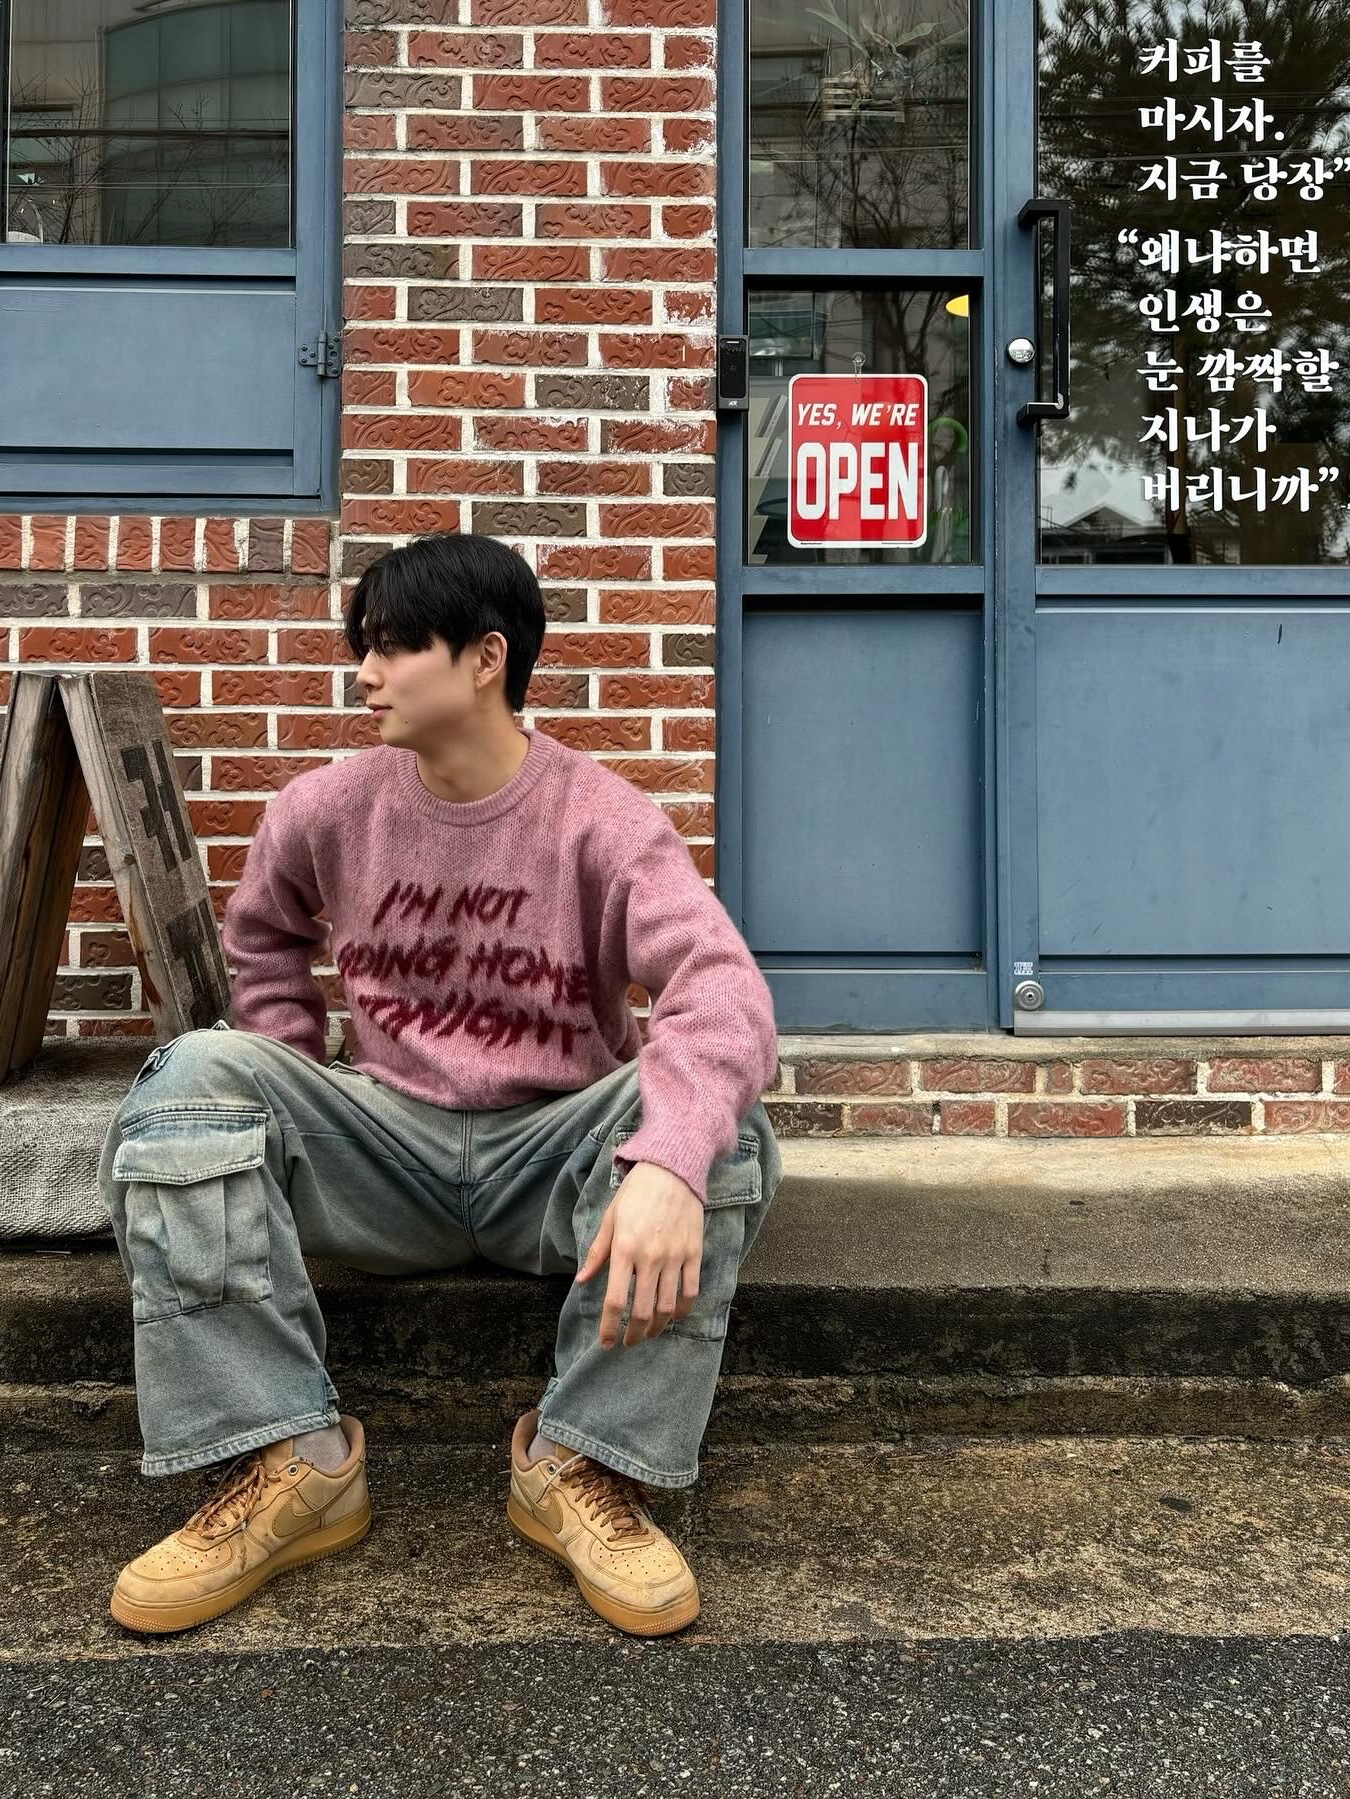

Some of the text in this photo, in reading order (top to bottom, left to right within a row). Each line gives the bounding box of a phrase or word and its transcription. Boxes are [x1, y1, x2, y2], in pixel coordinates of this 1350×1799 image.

[1138, 37, 1271, 83] 커피를
[1138, 97, 1285, 142] 마시자.
[1137, 156, 1350, 201] 지금 당장”
[1117, 228, 1320, 274] “왜냐하면
[1139, 288, 1273, 333] 인생은
[1137, 348, 1340, 393] 눈 깜짝할
[797, 403, 920, 430] YES, WE'RE
[1139, 407, 1277, 453] 지나가
[796, 442, 919, 520] OPEN
[1142, 466, 1339, 512] 버리니까”
[372, 879, 532, 928] I'M NOT
[466, 940, 589, 1006] HOME
